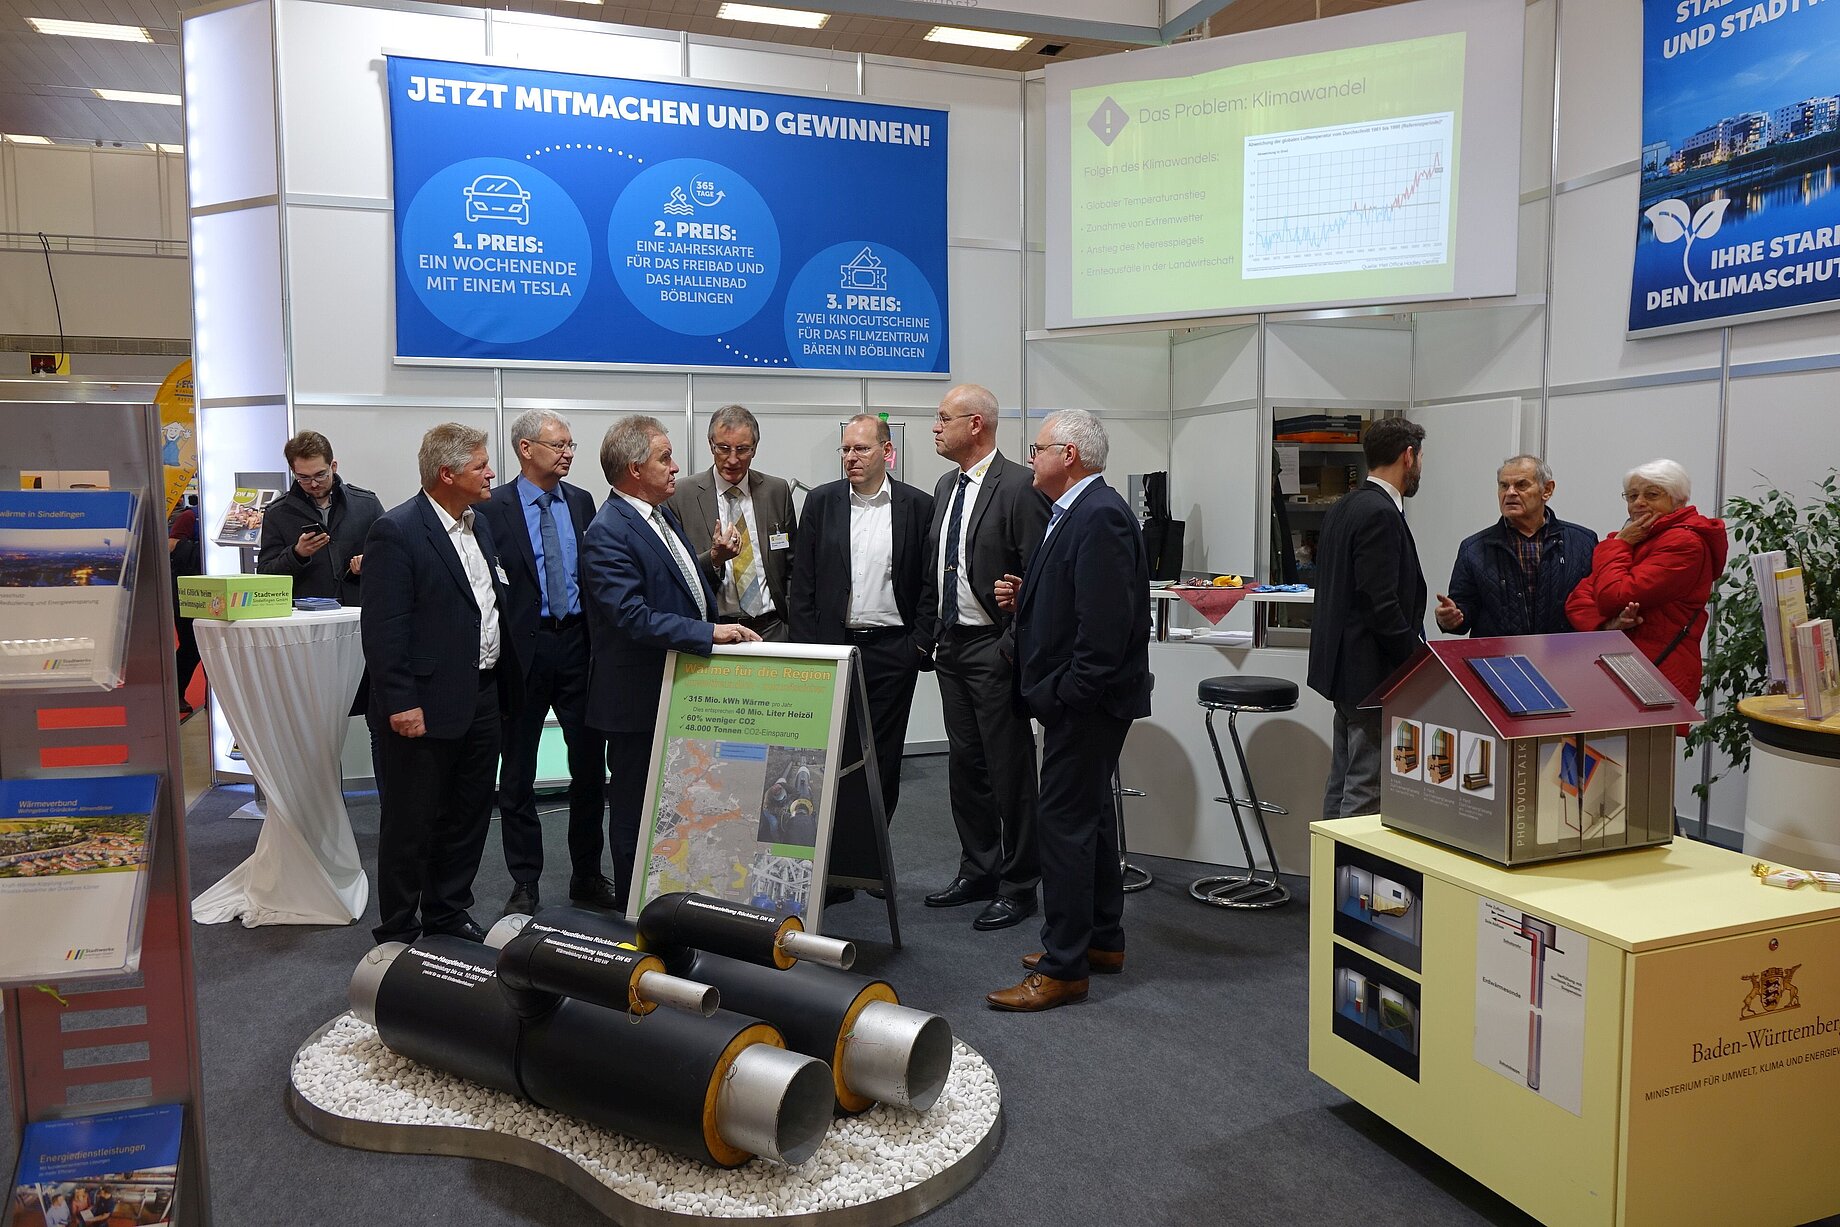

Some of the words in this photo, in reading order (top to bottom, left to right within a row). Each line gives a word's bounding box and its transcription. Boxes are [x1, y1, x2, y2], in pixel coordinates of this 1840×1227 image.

[1676, 0, 1735, 23] STA
[1663, 23, 1716, 59] UND
[407, 75, 508, 109] JETZT
[515, 85, 700, 126] MITMACHEN
[707, 104, 769, 132] UND
[775, 111, 930, 147] GEWINNEN!
[1139, 106, 1171, 125] Das
[1174, 96, 1248, 121] Problem:
[1252, 77, 1367, 109] Klimawandel
[1084, 163, 1117, 179] Folgen
[1119, 160, 1139, 173] des
[1142, 151, 1220, 171] Klimawandels:
[696, 180, 714, 191] 365
[696, 190, 715, 198] TAGE
[1086, 198, 1121, 211] Globaler
[1123, 189, 1206, 210] Temperaturanstieg
[655, 220, 674, 238] 2.
[677, 221, 738, 241] PREIS:
[1086, 219, 1124, 233] Zunahme
[1126, 219, 1143, 229] von
[1145, 212, 1204, 227] Extremwetter
[453, 233, 473, 251] 1.
[476, 234, 544, 254] PREIS:
[636, 241, 665, 255] EINE
[667, 241, 755, 259] JAHRESKARTE
[1086, 243, 1117, 257] Anstieg
[1119, 241, 1135, 253] des
[1136, 235, 1205, 252] Meeresspiegels
[419, 254, 455, 270] EIN
[456, 255, 578, 277] WOCHENENDE
[626, 253, 653, 269] FÜR
[655, 256, 681, 271] DAS
[683, 257, 735, 273] FREIBAD
[737, 259, 765, 275] UND
[1142, 262, 1151, 273] in
[1152, 261, 1166, 272] der
[1168, 254, 1235, 270] Landwirtschaft
[1710, 240, 1765, 270] IHRE
[426, 275, 458, 292] MIT
[462, 276, 518, 295] EINEM
[520, 279, 572, 297] TESLA
[646, 273, 672, 287] DAS
[673, 274, 747, 290] HALLENBAD
[660, 287, 734, 305] BÖBLINGEN
[826, 294, 843, 309] 3.
[846, 294, 901, 313] PREIS:
[1646, 284, 1689, 311] DEN
[796, 313, 827, 327] ZWEI
[828, 314, 930, 330] KINOGUTSCHEINE
[797, 326, 822, 341] FÜR
[824, 328, 847, 342] DAS
[850, 329, 930, 345] FILMZENTRUM
[803, 341, 843, 357] BÄREN
[844, 343, 857, 357] IN
[859, 342, 926, 359] BÖBLINGEN
[27, 510, 36, 518] in
[37, 510, 86, 520] Sindelfingen
[757, 667, 778, 678] die
[783, 667, 832, 682] Region
[688, 695, 703, 703] 315
[704, 696, 721, 704] Mio.
[722, 697, 740, 705] kWh
[742, 698, 770, 707] Wärme
[686, 714, 703, 722] 60%
[705, 716, 737, 726] weniger
[739, 717, 756, 725] CO2
[747, 708, 764, 716] Mio.
[766, 709, 785, 717] Liter
[787, 710, 814, 719] Heizöl
[685, 724, 712, 733] 48.000
[713, 725, 742, 735] Tonnen
[744, 727, 800, 740] CO2-Einsparung
[19, 799, 78, 808] Wärmeverbund
[1516, 743, 1528, 847] PHOTOVOLTAIK
[1691, 1015, 1840, 1064] Baden-Württember
[1645, 1079, 1702, 1102] MINISTERIUM
[1703, 1073, 1720, 1088] FÜR
[1721, 1065, 1759, 1083] UMWELT,
[1759, 1060, 1785, 1073] KLIMA
[1786, 1055, 1804, 1067] UND
[40, 1143, 146, 1164] Energiedienstleistungen
